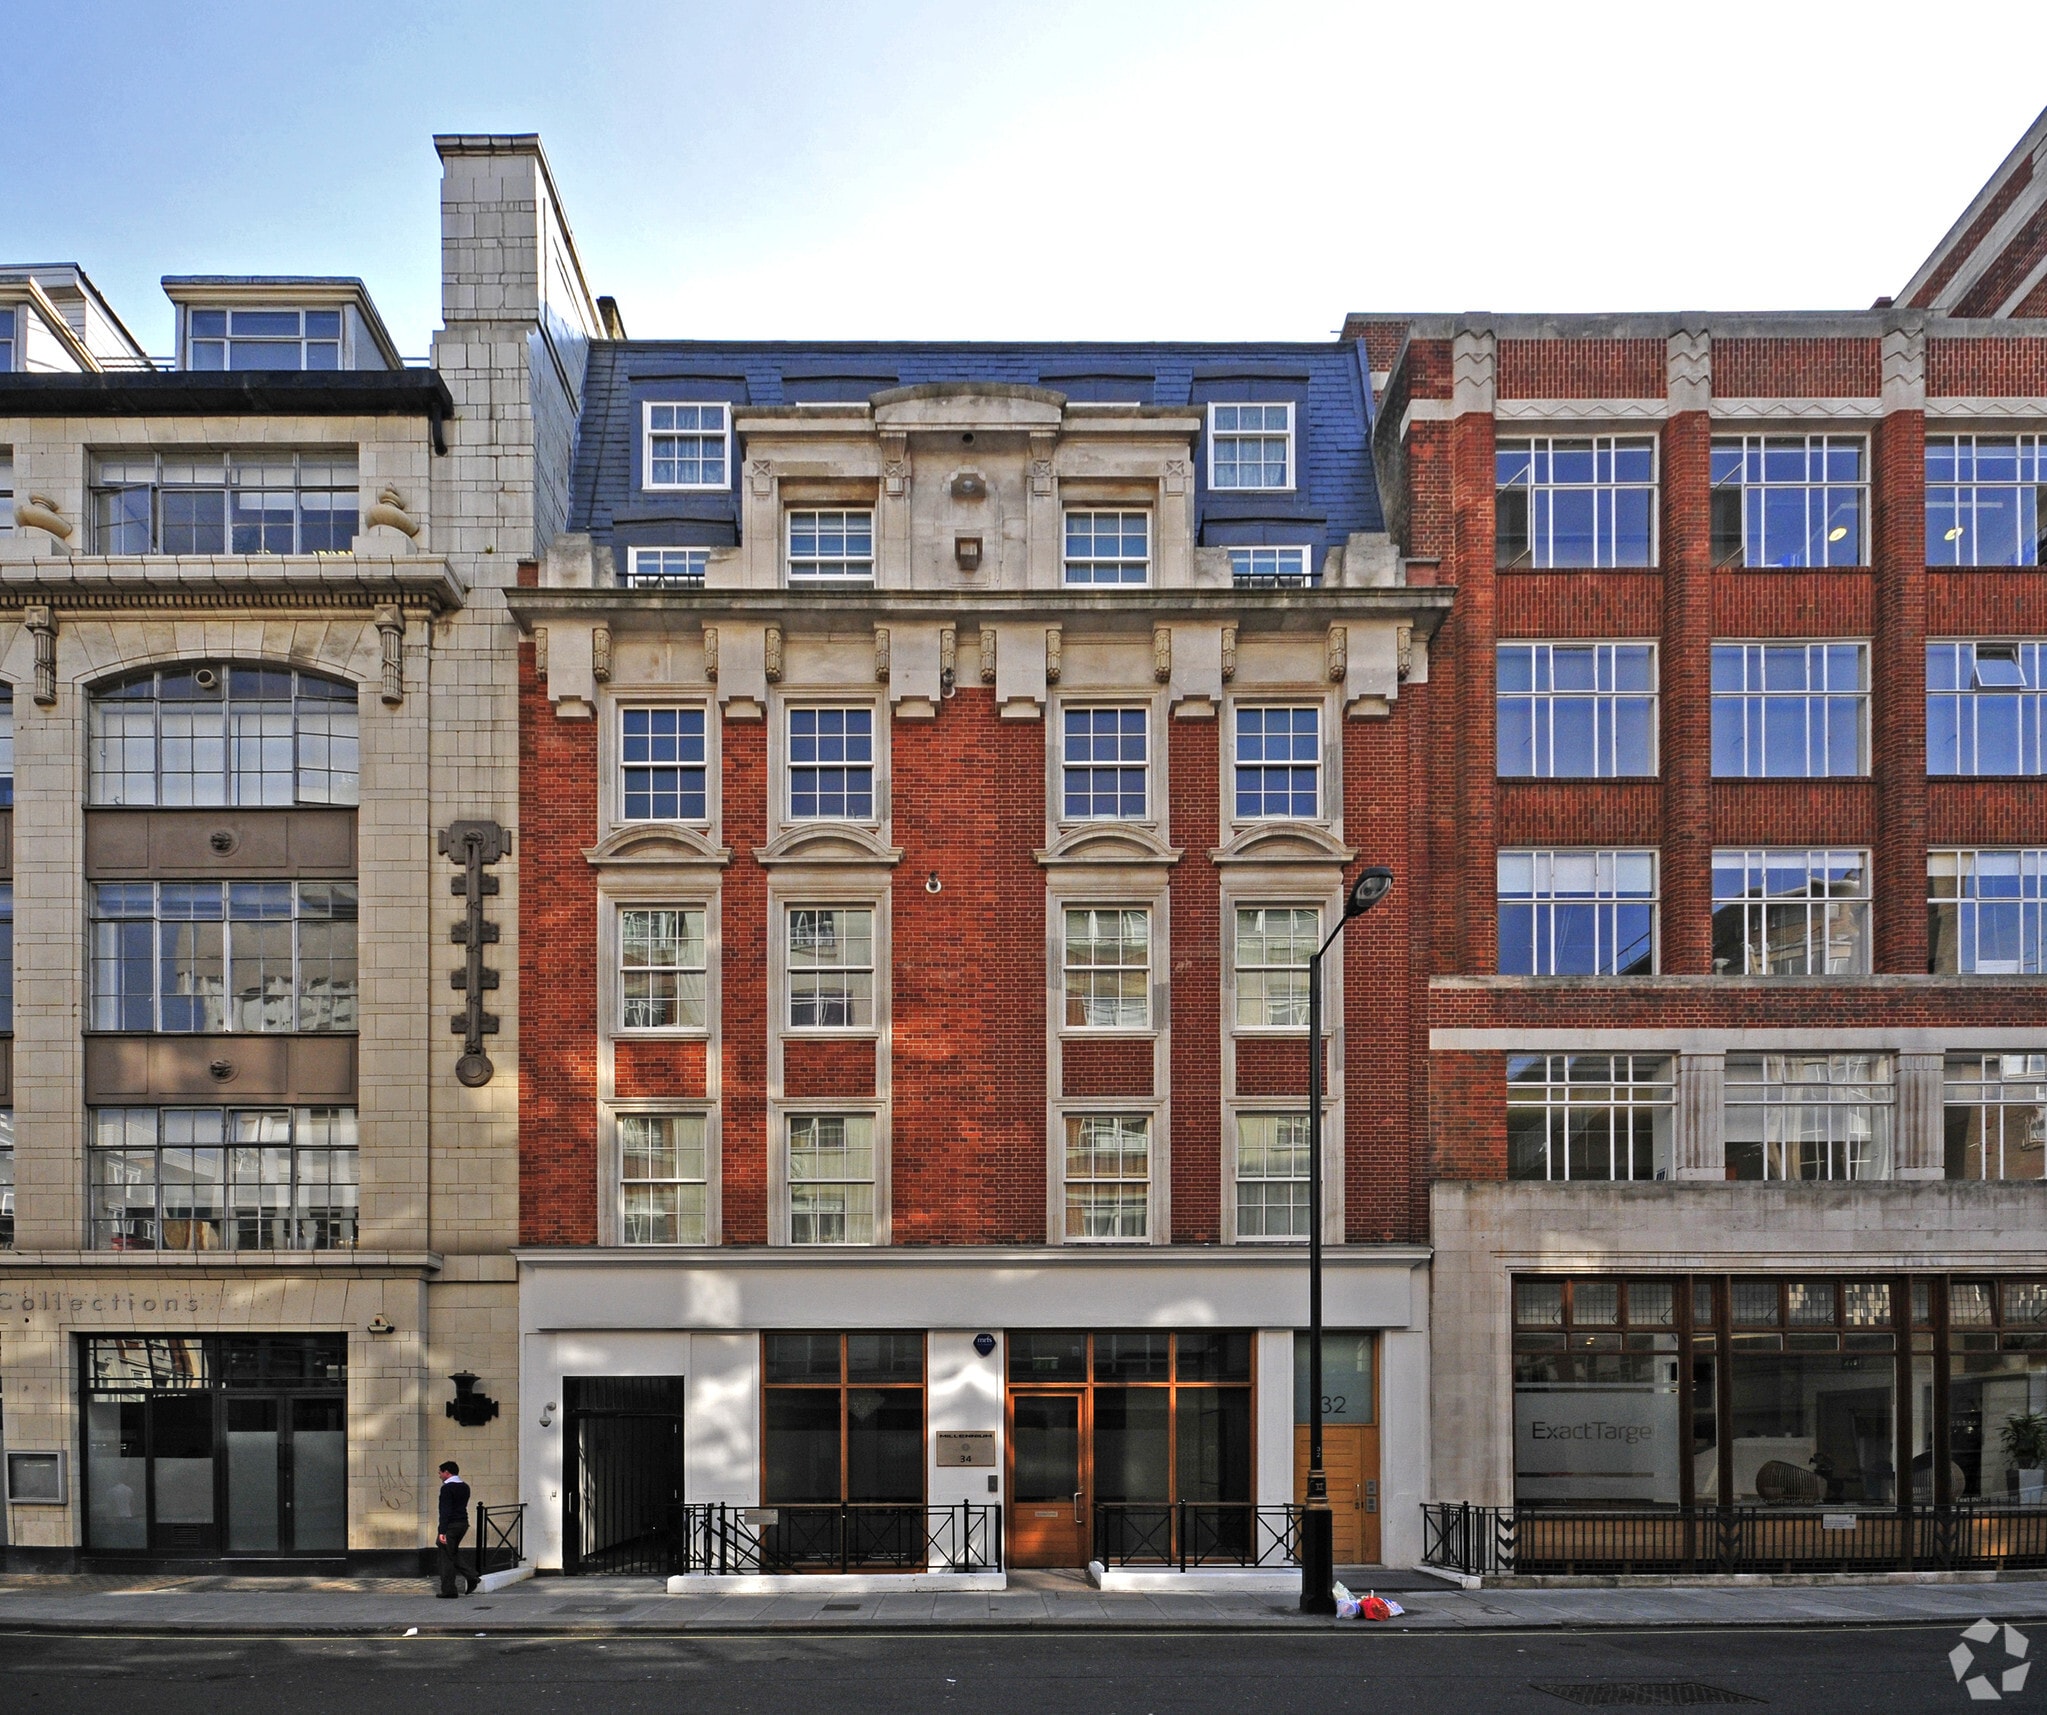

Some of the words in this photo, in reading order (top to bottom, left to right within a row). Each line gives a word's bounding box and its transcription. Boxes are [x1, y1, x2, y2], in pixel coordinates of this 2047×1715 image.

[0, 1291, 198, 1312] Collections
[1321, 1395, 1346, 1414] 32
[1532, 1421, 1655, 1444] ExactTarge
[960, 1454, 972, 1463] 34
